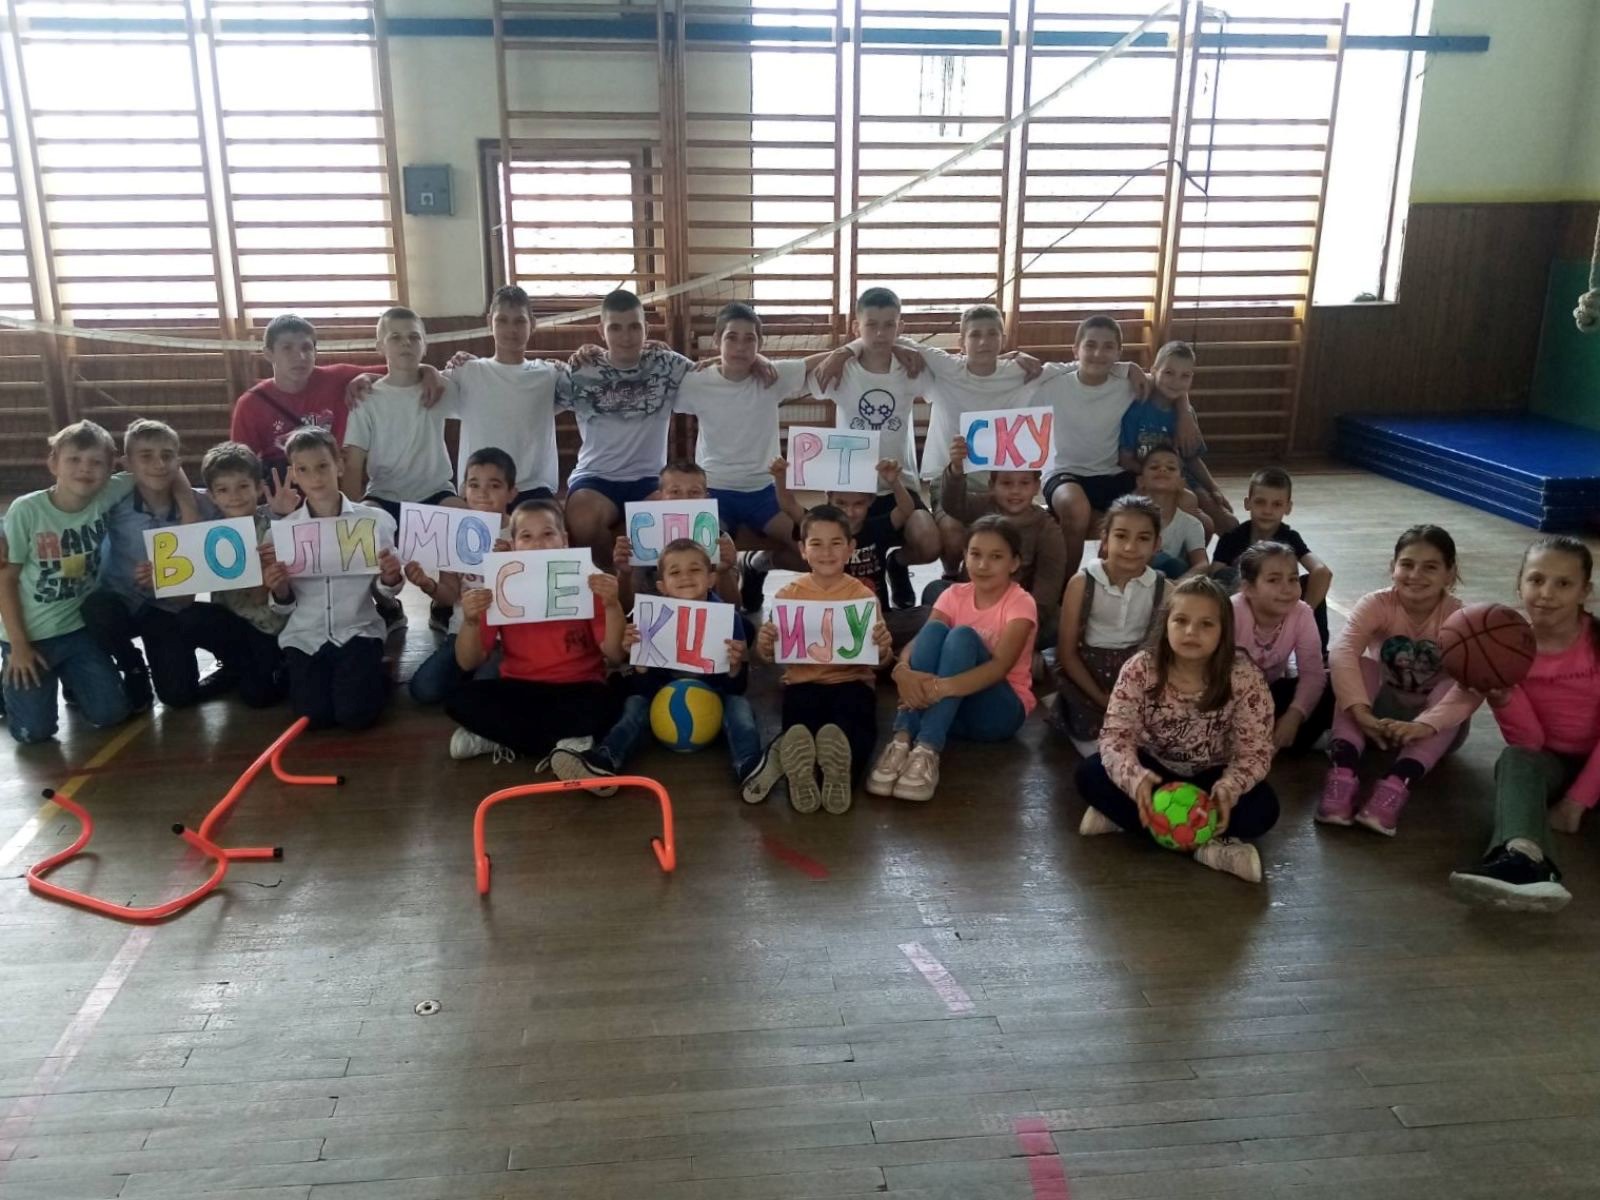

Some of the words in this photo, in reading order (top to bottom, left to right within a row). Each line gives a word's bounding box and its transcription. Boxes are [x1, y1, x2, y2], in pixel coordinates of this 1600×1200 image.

[793, 432, 870, 486] РТ
[966, 413, 1052, 468] СКУ
[153, 525, 246, 589] ВО
[287, 518, 378, 574] ЛИ
[402, 509, 491, 567] МО
[630, 511, 718, 561] СПО
[496, 560, 581, 618] СЕ
[636, 601, 715, 673] КЦ
